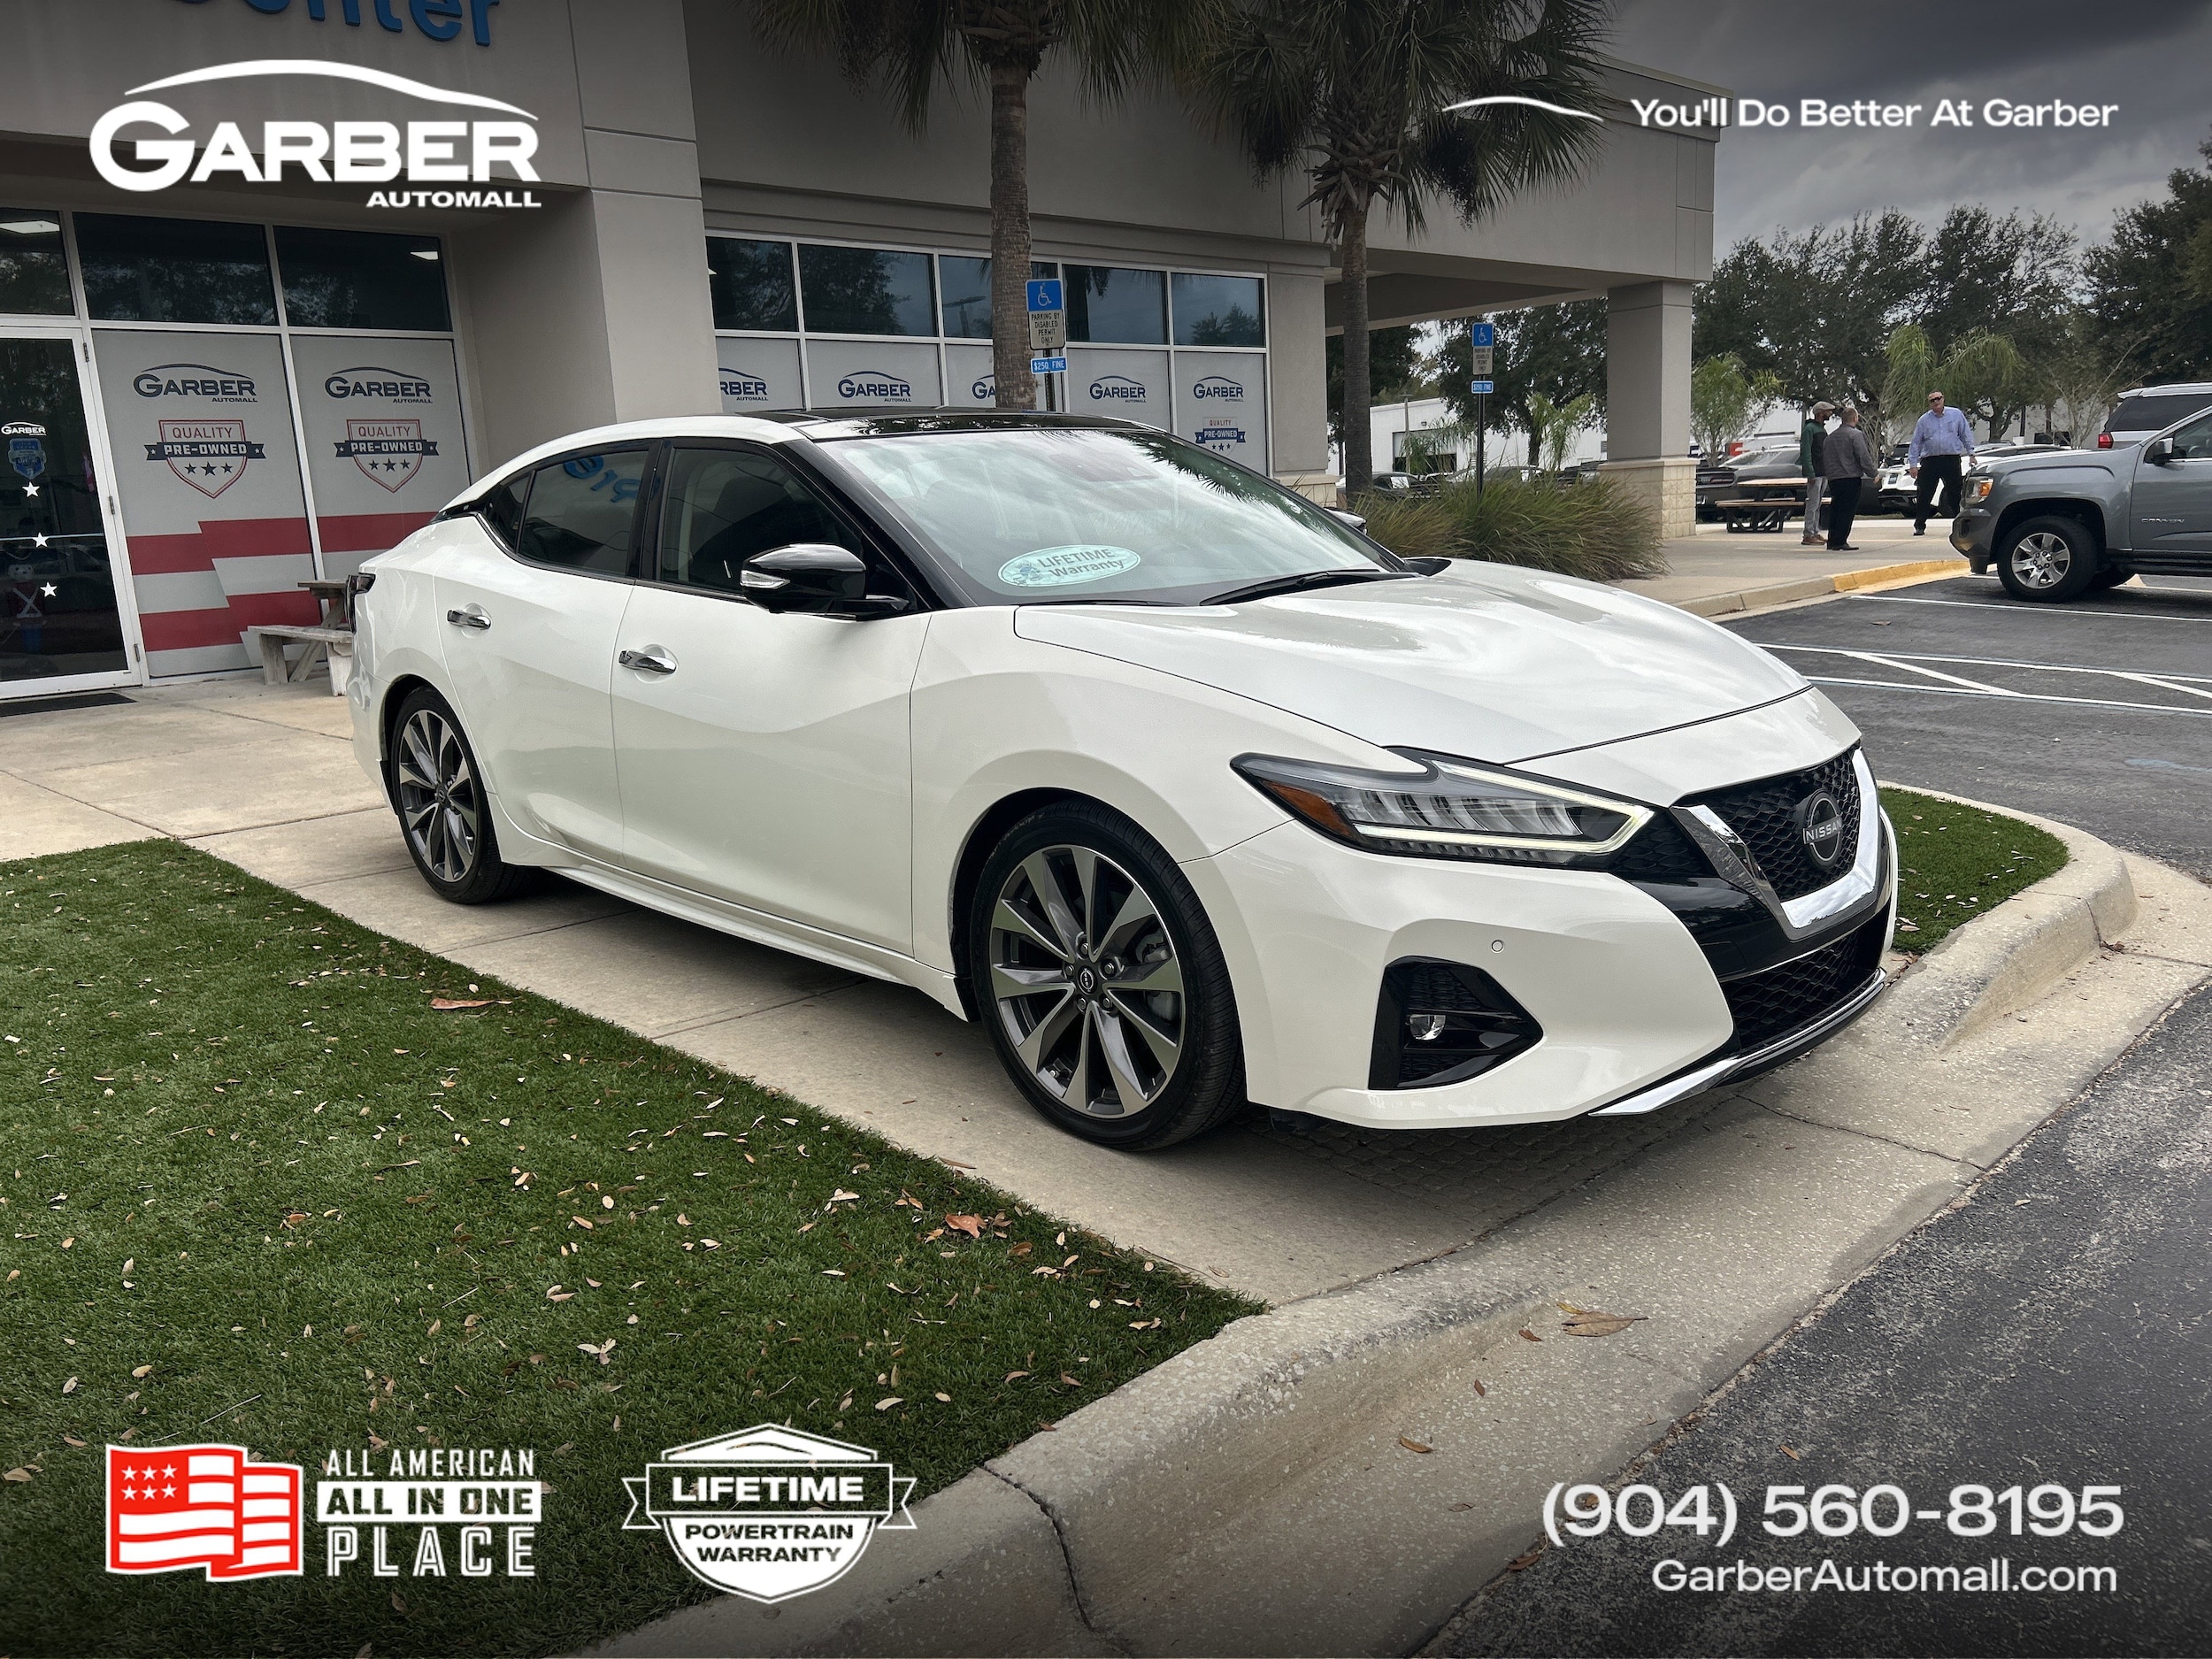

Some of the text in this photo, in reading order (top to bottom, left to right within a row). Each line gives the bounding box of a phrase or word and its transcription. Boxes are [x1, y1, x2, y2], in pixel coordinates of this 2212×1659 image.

[1052, 360, 1065, 369] FINE
[133, 373, 257, 397] GARBER
[325, 376, 432, 398] GARBER
[718, 381, 767, 396] RBER
[838, 379, 911, 398] GARBER
[1089, 383, 1147, 400] GARBER
[1193, 383, 1244, 399] GARBER
[1, 426, 46, 434] GARBER
[173, 427, 232, 439] QUALITY
[358, 426, 411, 437] QUALITY
[164, 443, 248, 456] PRE-OWNED
[351, 442, 423, 452] PRE-OWNED
[1037, 549, 1116, 568] LIFETIME
[1048, 558, 1125, 577] Warranty
[1805, 819, 1842, 841] NISSAN
